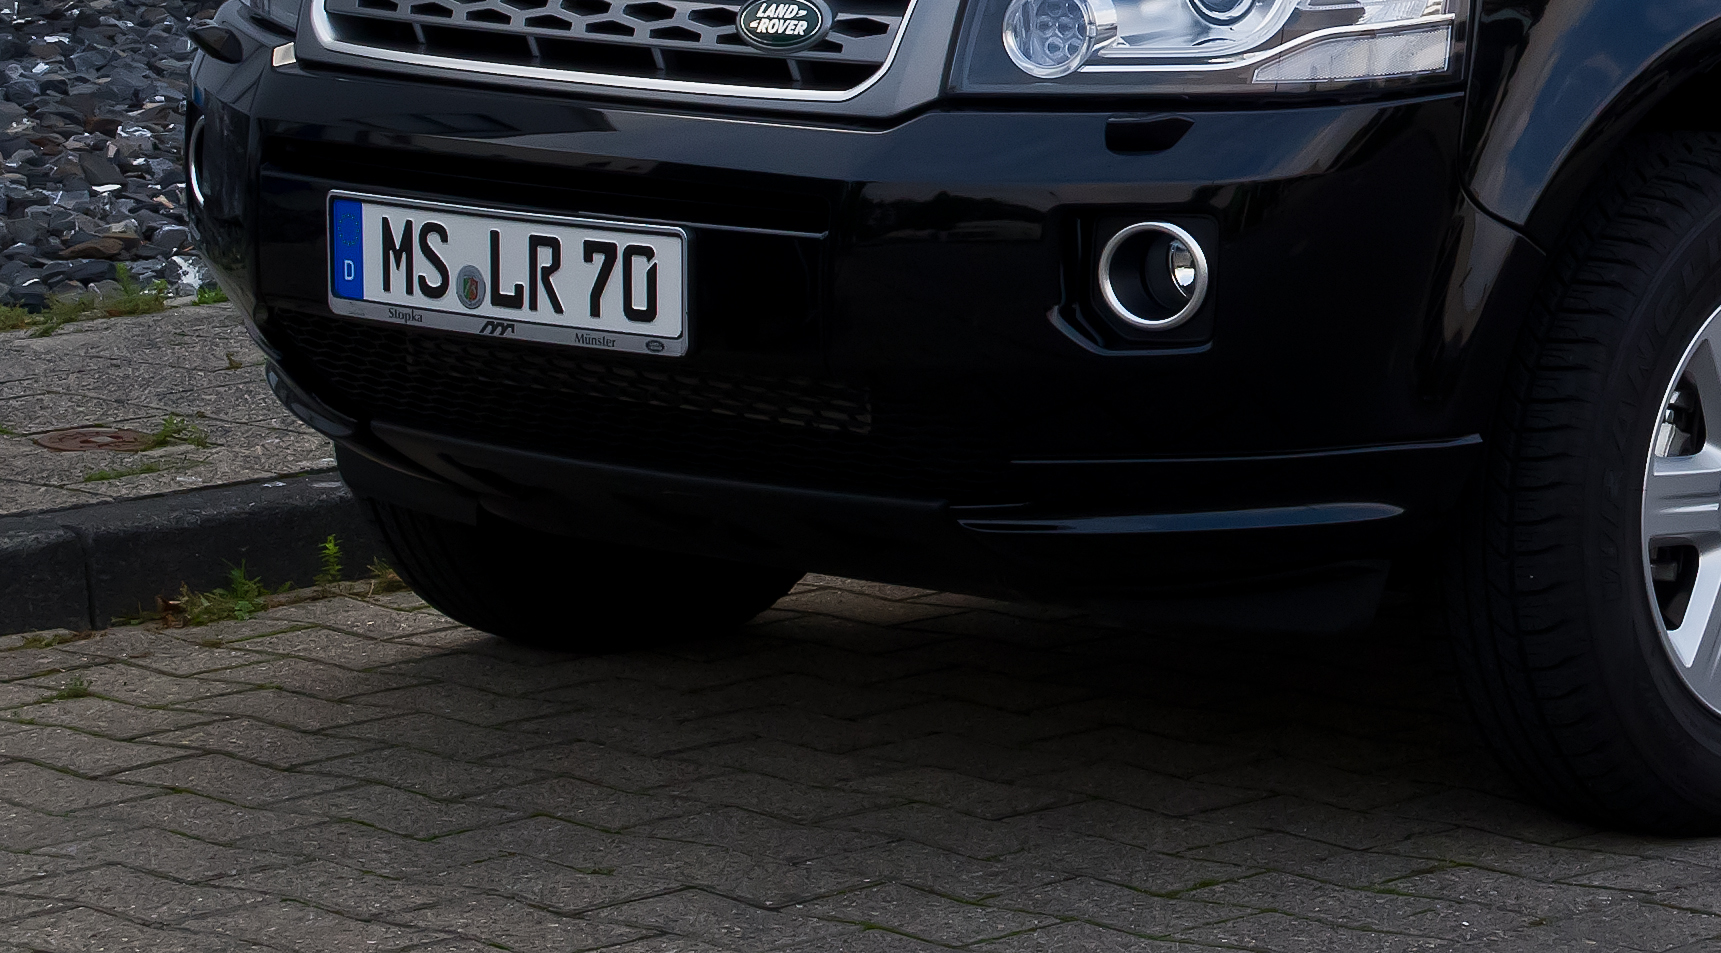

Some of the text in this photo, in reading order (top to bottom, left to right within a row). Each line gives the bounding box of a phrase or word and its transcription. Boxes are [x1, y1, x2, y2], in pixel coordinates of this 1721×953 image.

[756, 2, 799, 18] LAND
[756, 18, 808, 36] ROVER
[343, 259, 355, 282] D
[381, 216, 657, 323] MS LR 70
[388, 307, 617, 348] Stopka Münster
